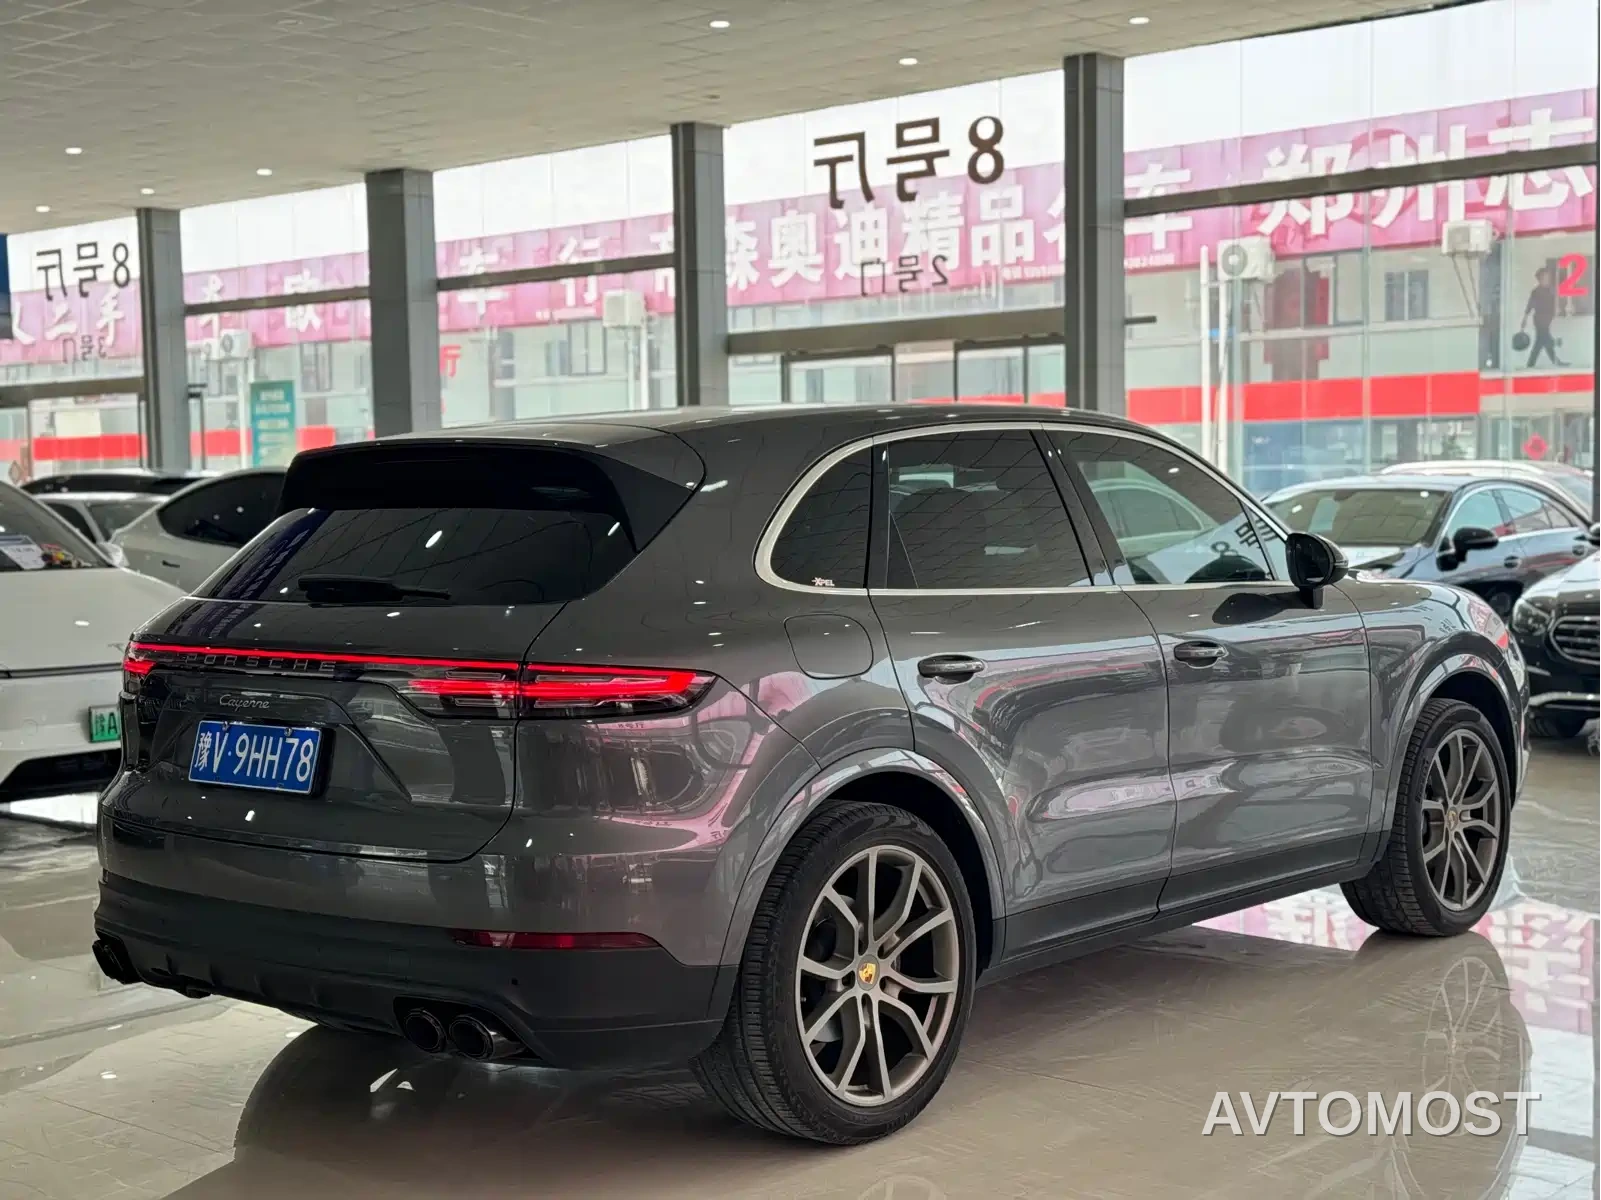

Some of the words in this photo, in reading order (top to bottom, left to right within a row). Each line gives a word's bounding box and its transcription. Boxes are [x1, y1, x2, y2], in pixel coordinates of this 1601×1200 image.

[1555, 253, 1589, 297] 2
[184, 653, 336, 672] PORSCHE
[219, 693, 271, 712] Cayenne
